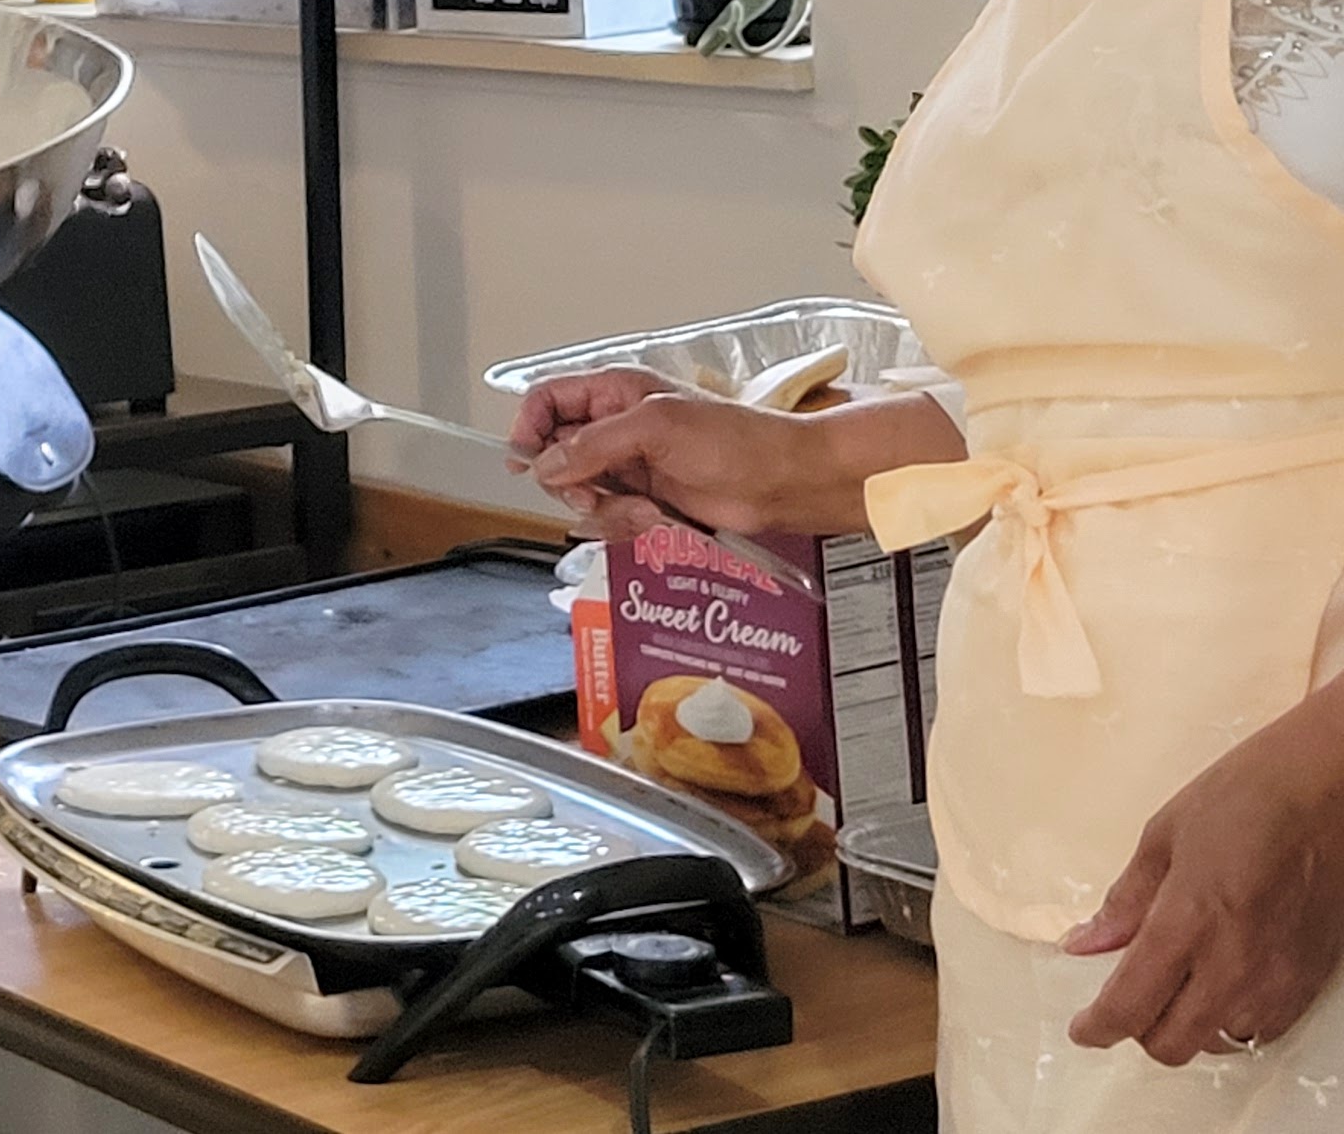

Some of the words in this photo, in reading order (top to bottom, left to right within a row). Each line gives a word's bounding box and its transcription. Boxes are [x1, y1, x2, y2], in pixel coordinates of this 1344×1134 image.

[666, 575, 698, 592] LIGHT
[620, 580, 702, 633] Sweet
[704, 599, 803, 656] Cream
